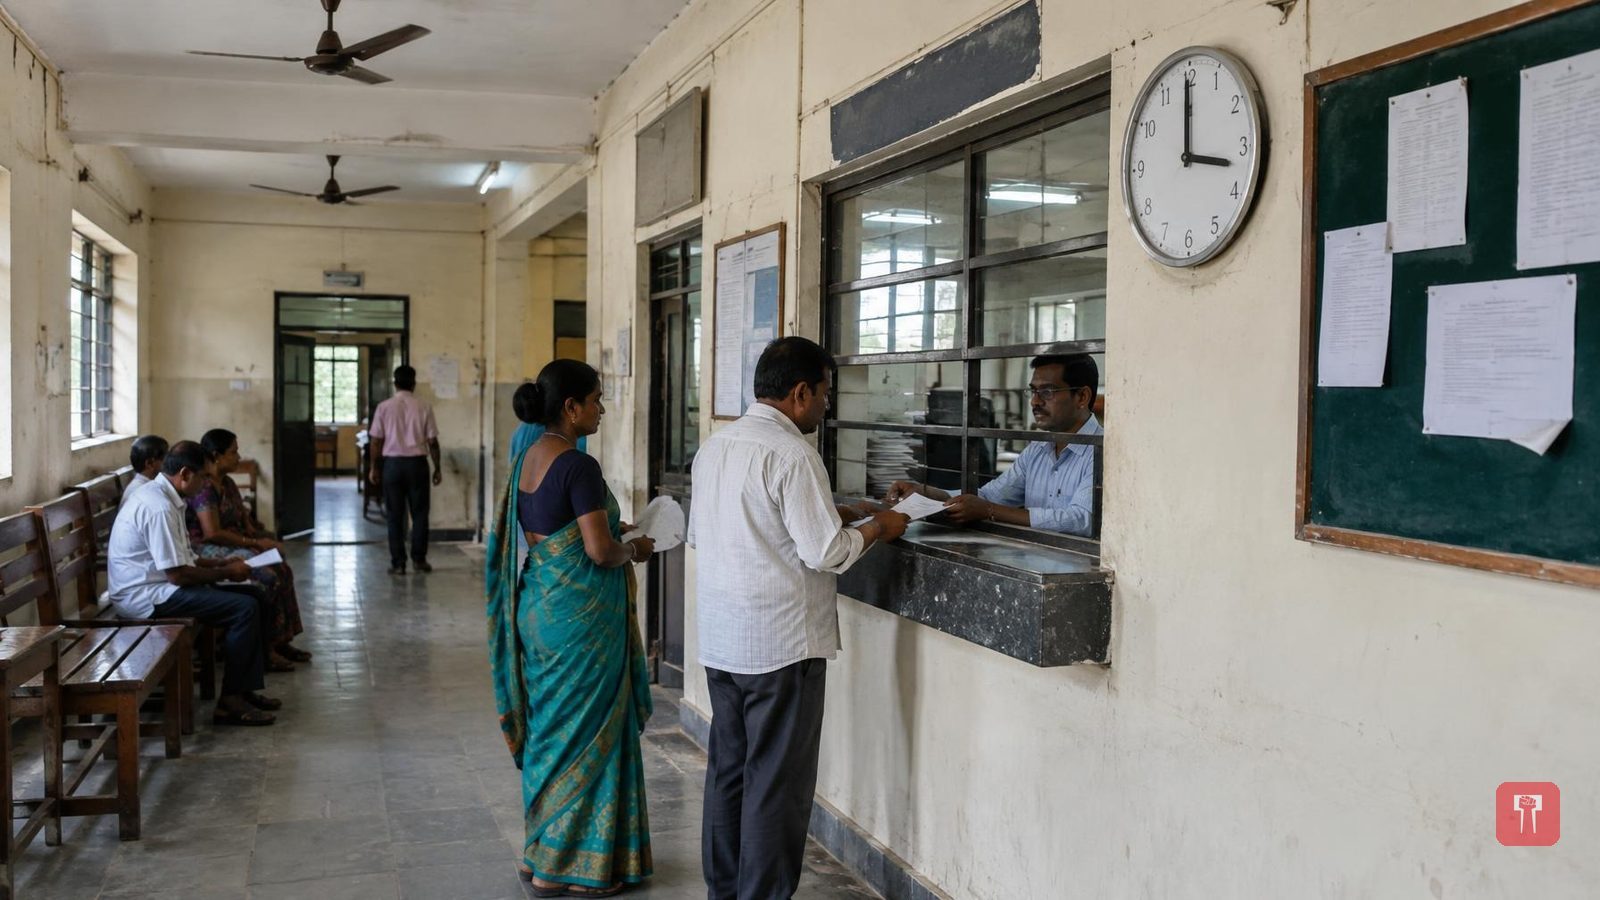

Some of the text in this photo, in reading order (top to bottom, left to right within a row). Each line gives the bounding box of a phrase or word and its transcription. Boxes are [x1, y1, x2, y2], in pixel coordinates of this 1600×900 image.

[1214, 71, 1218, 90] 1
[1161, 87, 1170, 106] 11
[1231, 94, 1240, 114] 2
[1144, 120, 1156, 138] 10
[1239, 136, 1248, 156] 3
[1137, 160, 1145, 178] 9
[1230, 180, 1239, 199] 4
[1144, 197, 1152, 215] 8
[1161, 222, 1169, 240] 7
[1210, 215, 1219, 235] 5
[1184, 229, 1193, 248] 6
